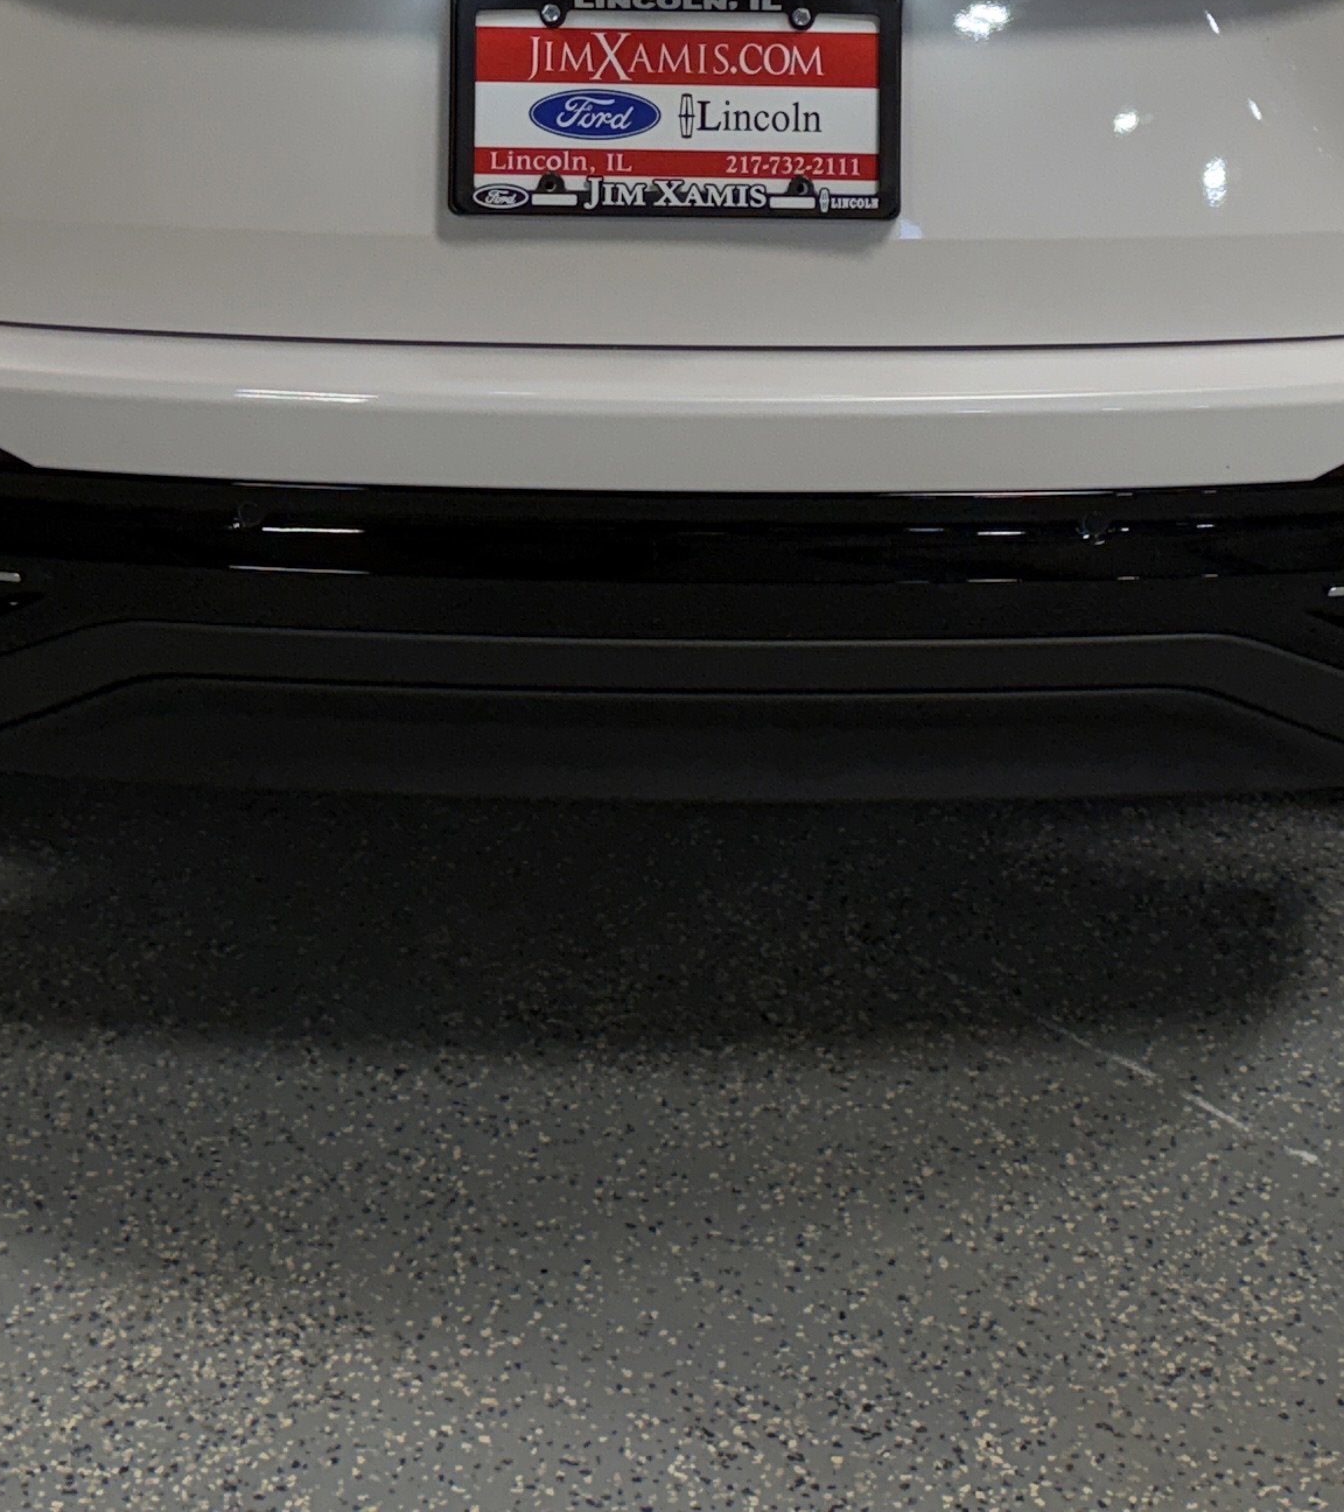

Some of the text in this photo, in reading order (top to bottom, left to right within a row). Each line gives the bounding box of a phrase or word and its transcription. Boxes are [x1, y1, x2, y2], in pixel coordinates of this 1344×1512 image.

[528, 31, 824, 82] JIMXAMIS.COM
[696, 100, 823, 133] Lincoln
[490, 150, 632, 173] Lincoln, IL
[726, 155, 861, 176] 217-732-2111
[583, 176, 767, 210] JIM XAMIS
[830, 197, 879, 209] LINCOLN
